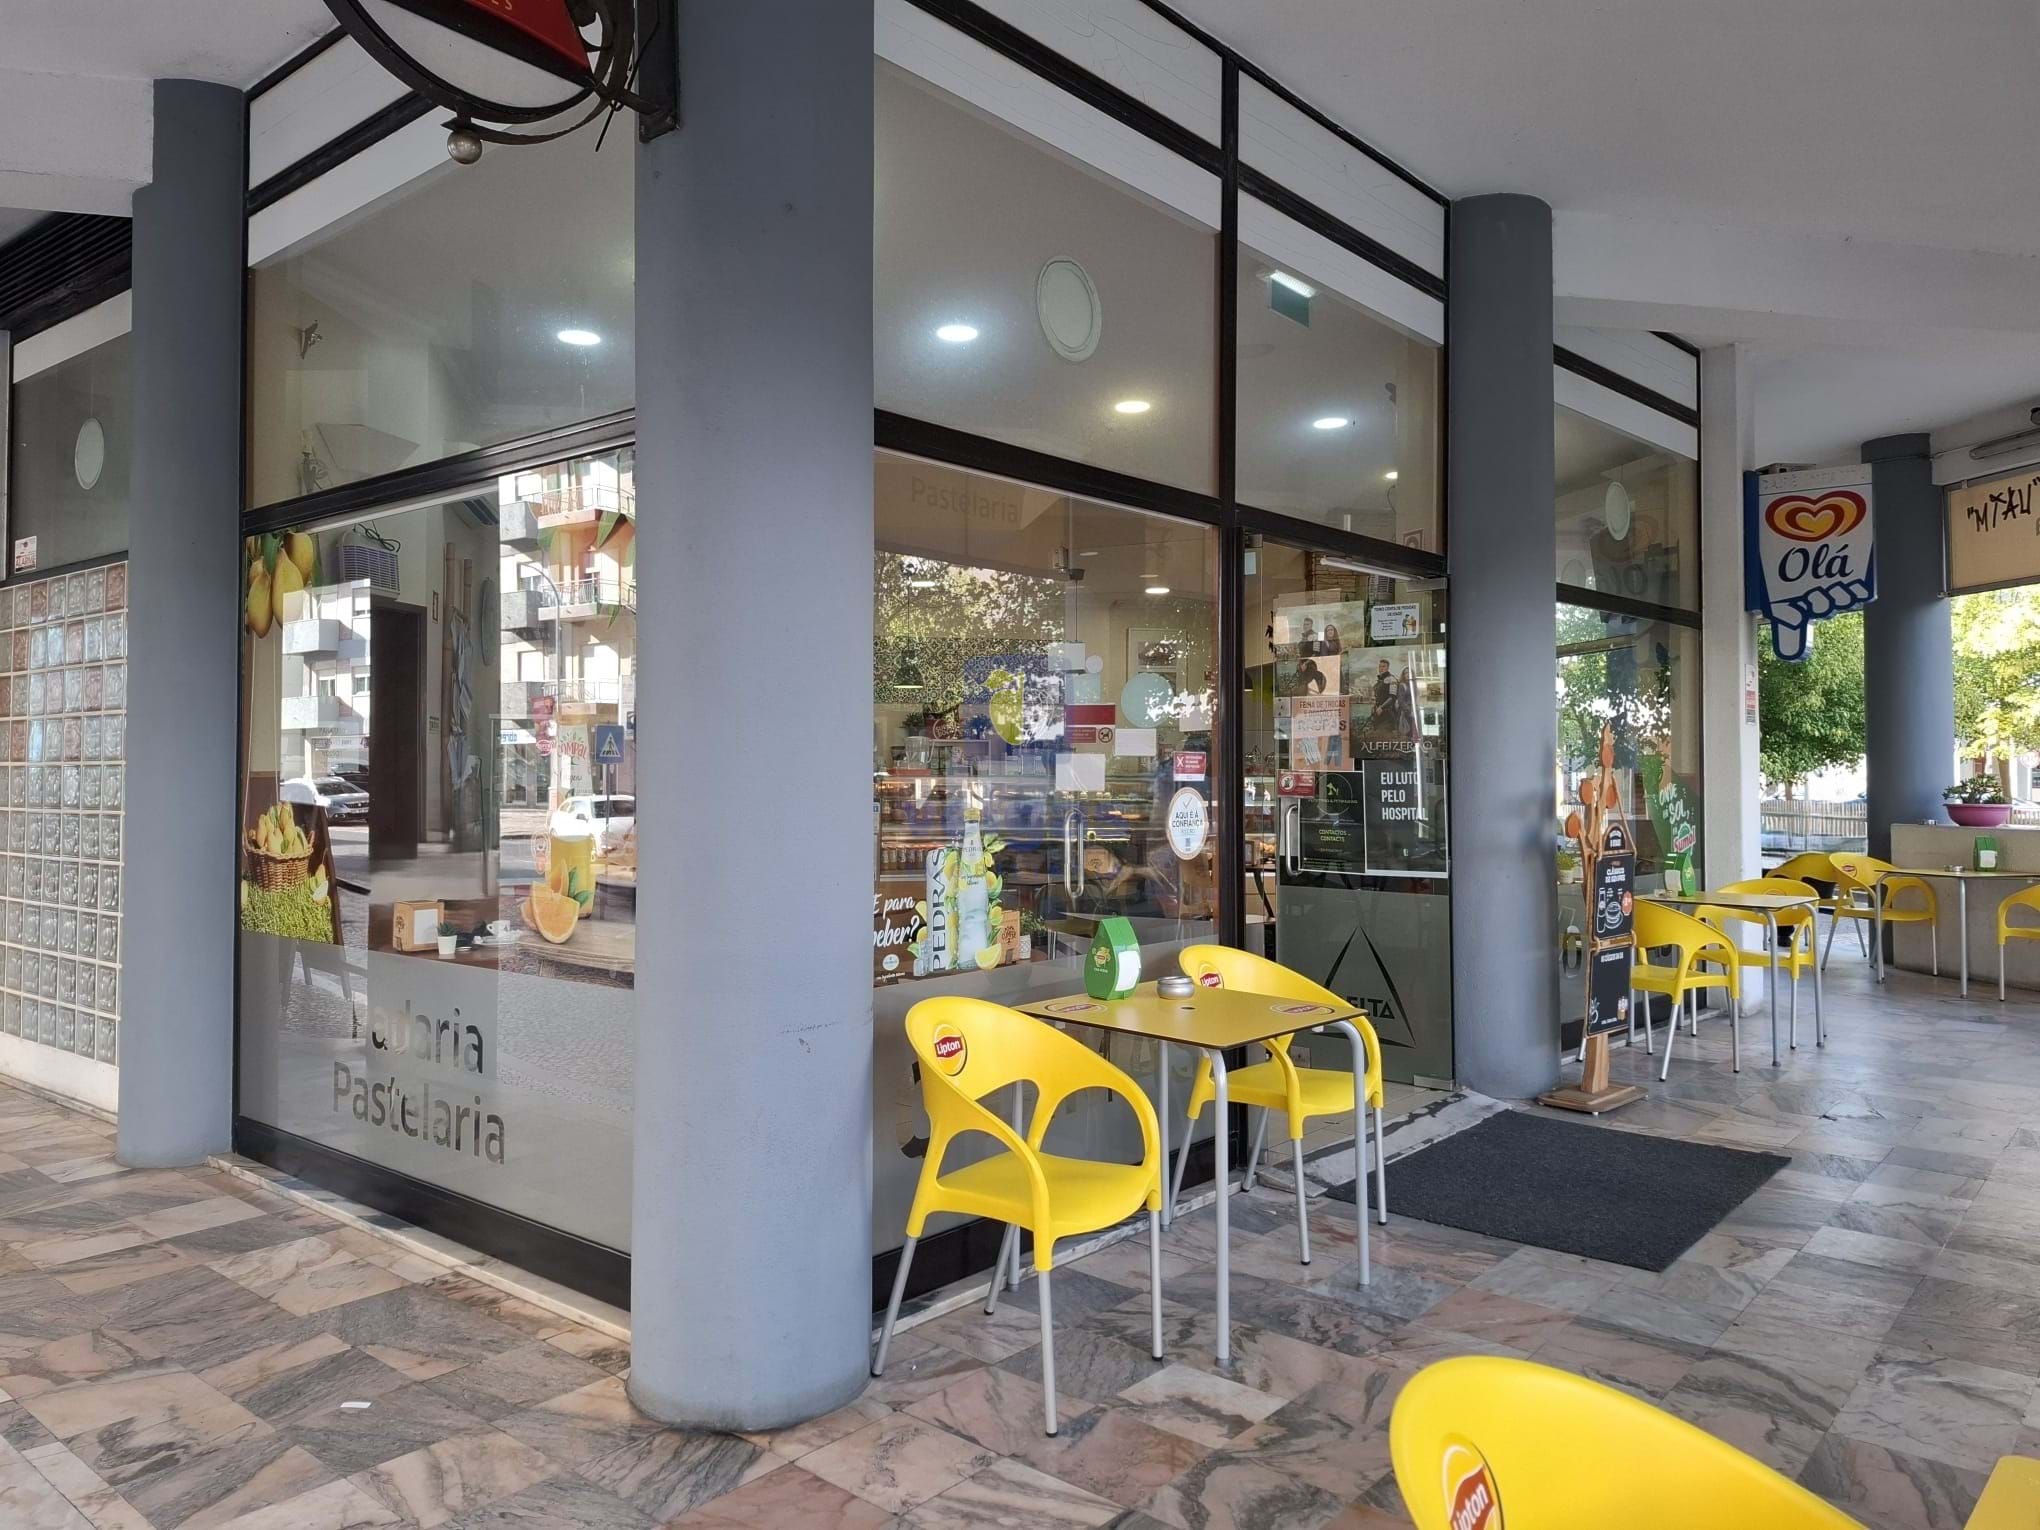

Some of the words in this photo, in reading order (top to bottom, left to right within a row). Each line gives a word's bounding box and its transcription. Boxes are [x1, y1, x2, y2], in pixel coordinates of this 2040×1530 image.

[911, 476, 1023, 523] Pastelaria
[1778, 543, 1854, 583] Olá
[1360, 740, 1433, 754] ALFEIZERO
[1380, 771, 1393, 785] EU
[1381, 789, 1406, 803] PELO
[1382, 807, 1429, 821] HOSPITAL
[882, 896, 916, 920] para
[932, 849, 946, 972] PEDRAS
[1201, 975, 1220, 987] Lipton
[1346, 995, 1396, 1020] ELTA
[936, 1040, 962, 1056] Lipton
[333, 1060, 505, 1166] Pastelaria
